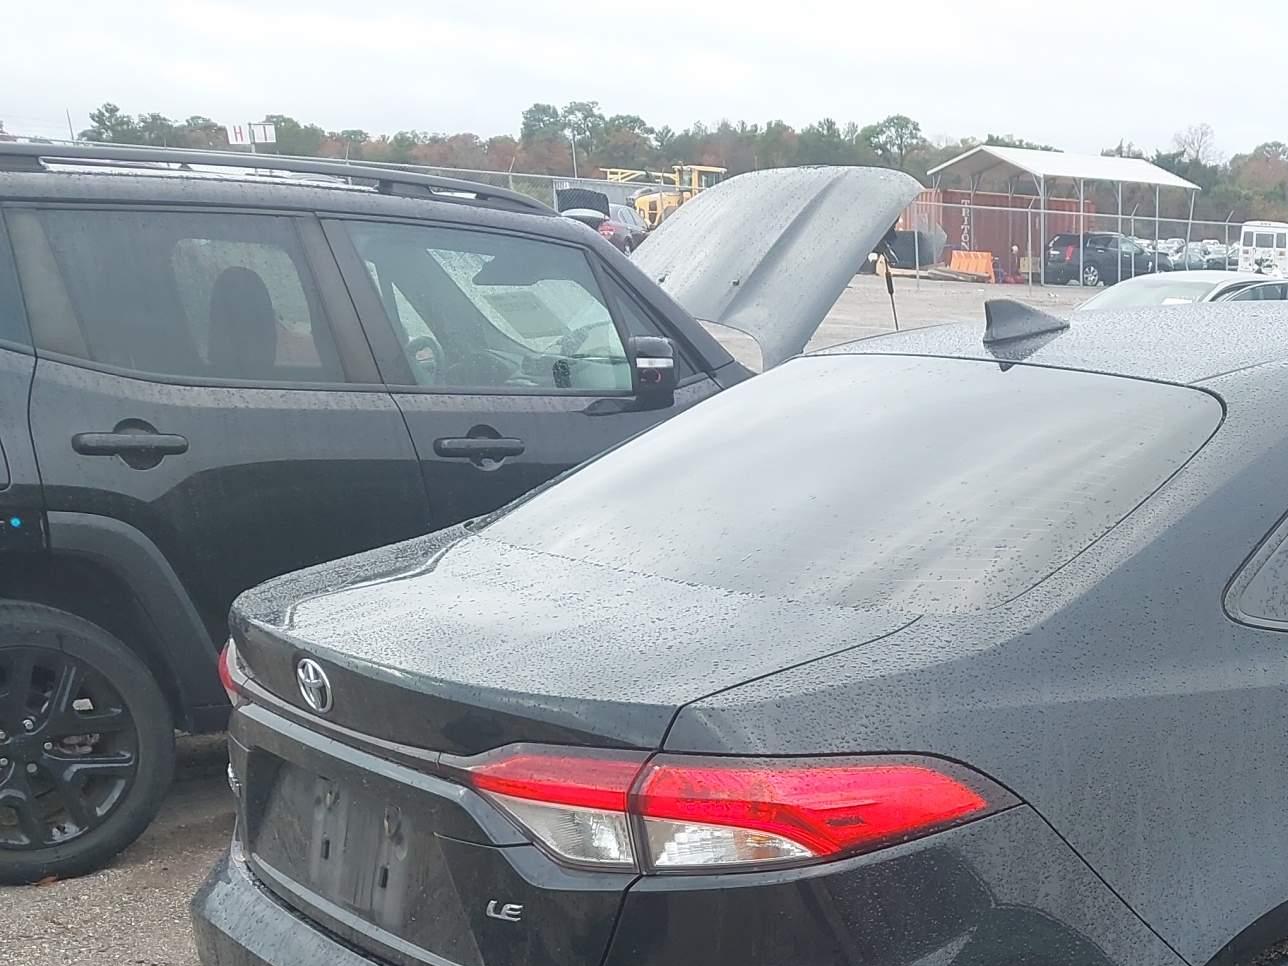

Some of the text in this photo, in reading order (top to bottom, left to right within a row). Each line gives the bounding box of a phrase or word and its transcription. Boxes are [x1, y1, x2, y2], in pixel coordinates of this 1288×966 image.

[233, 126, 243, 142] H
[961, 199, 970, 250] TRITON
[486, 900, 523, 921] LE
